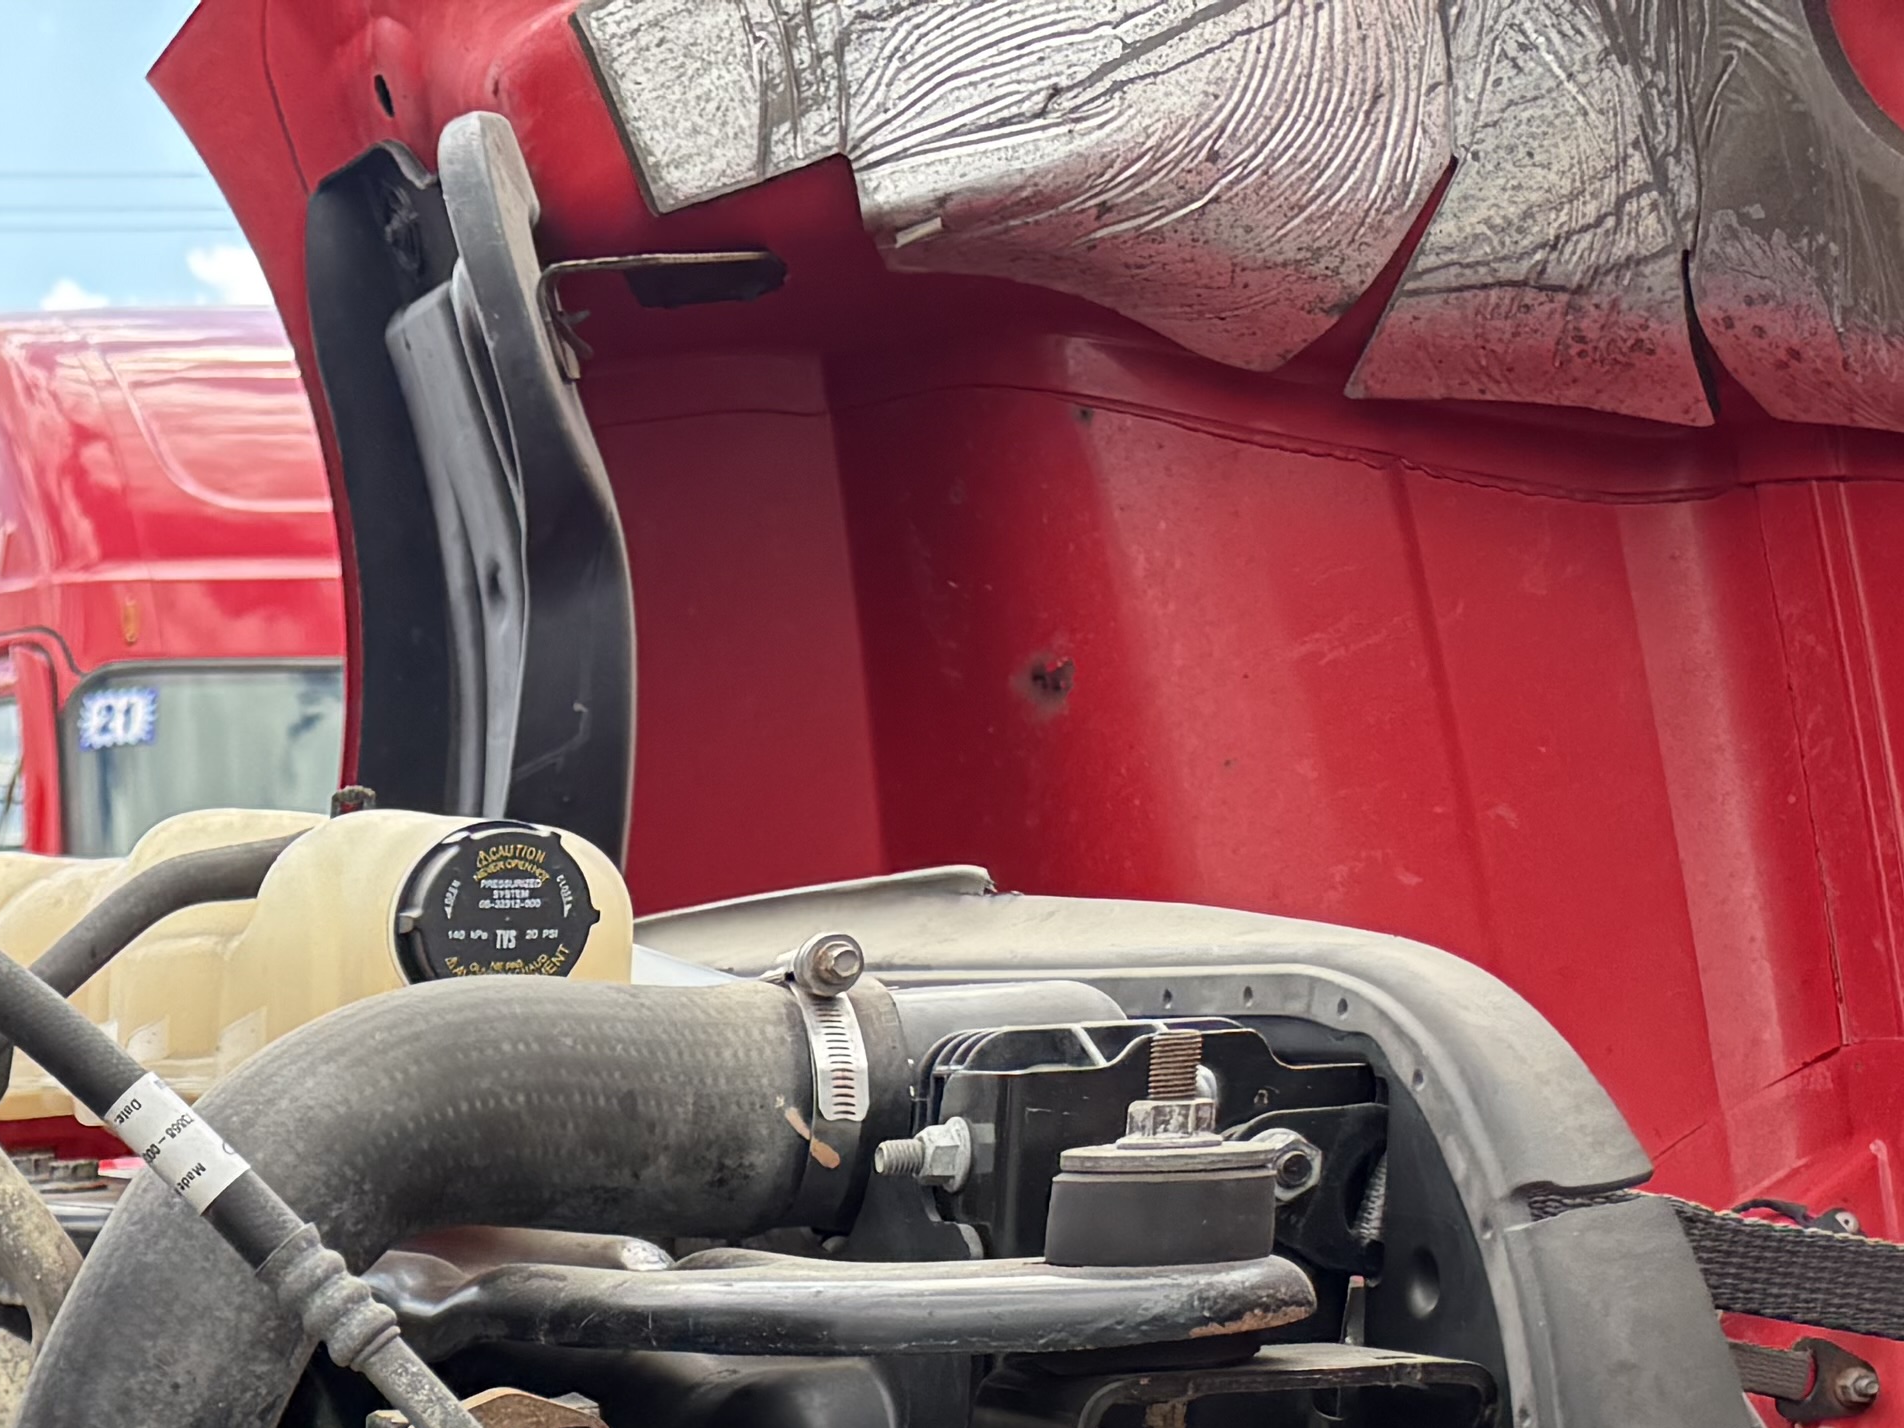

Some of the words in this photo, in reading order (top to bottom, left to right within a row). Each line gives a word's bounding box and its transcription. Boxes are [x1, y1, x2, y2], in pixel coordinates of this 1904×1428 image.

[489, 844, 546, 863] CAUTION
[480, 879, 542, 888] PRESSURIZED
[493, 890, 529, 899] SYSTEM
[448, 930, 465, 939] 140
[525, 929, 538, 939] 20
[542, 929, 558, 938] PSI
[496, 930, 517, 949] TVS
